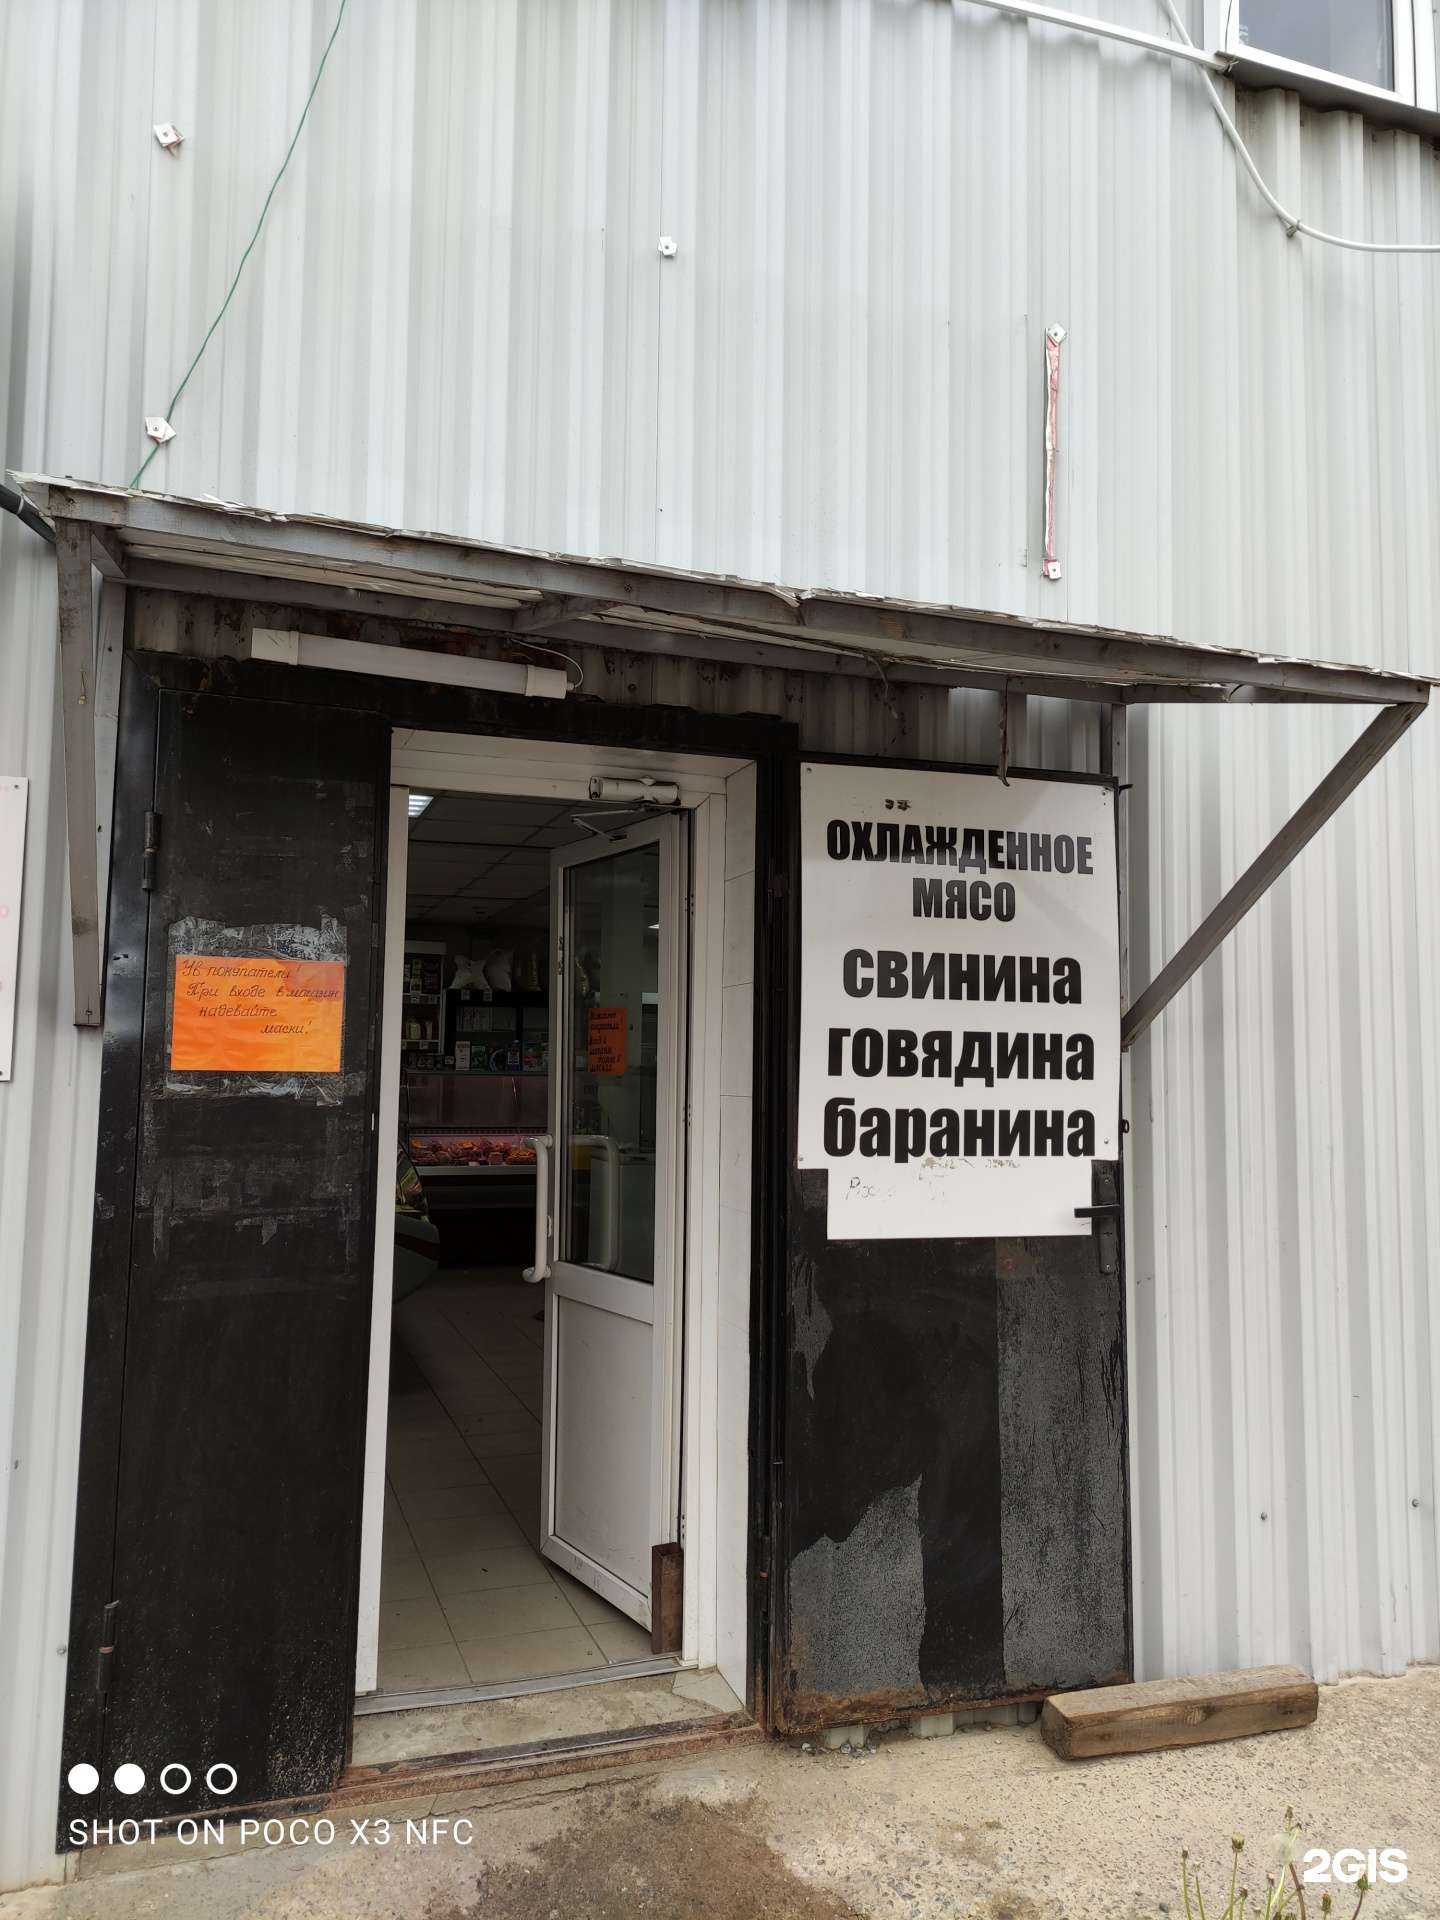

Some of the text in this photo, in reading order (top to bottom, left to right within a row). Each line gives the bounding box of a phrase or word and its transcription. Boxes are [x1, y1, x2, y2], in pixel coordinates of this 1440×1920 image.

[827, 819, 1093, 874] ОХЛАЖДЕННОЕ
[913, 878, 1015, 922] МЯСО
[199, 1003, 278, 1017] надевайте
[229, 983, 265, 998] входе
[824, 1098, 1095, 1163] баранина
